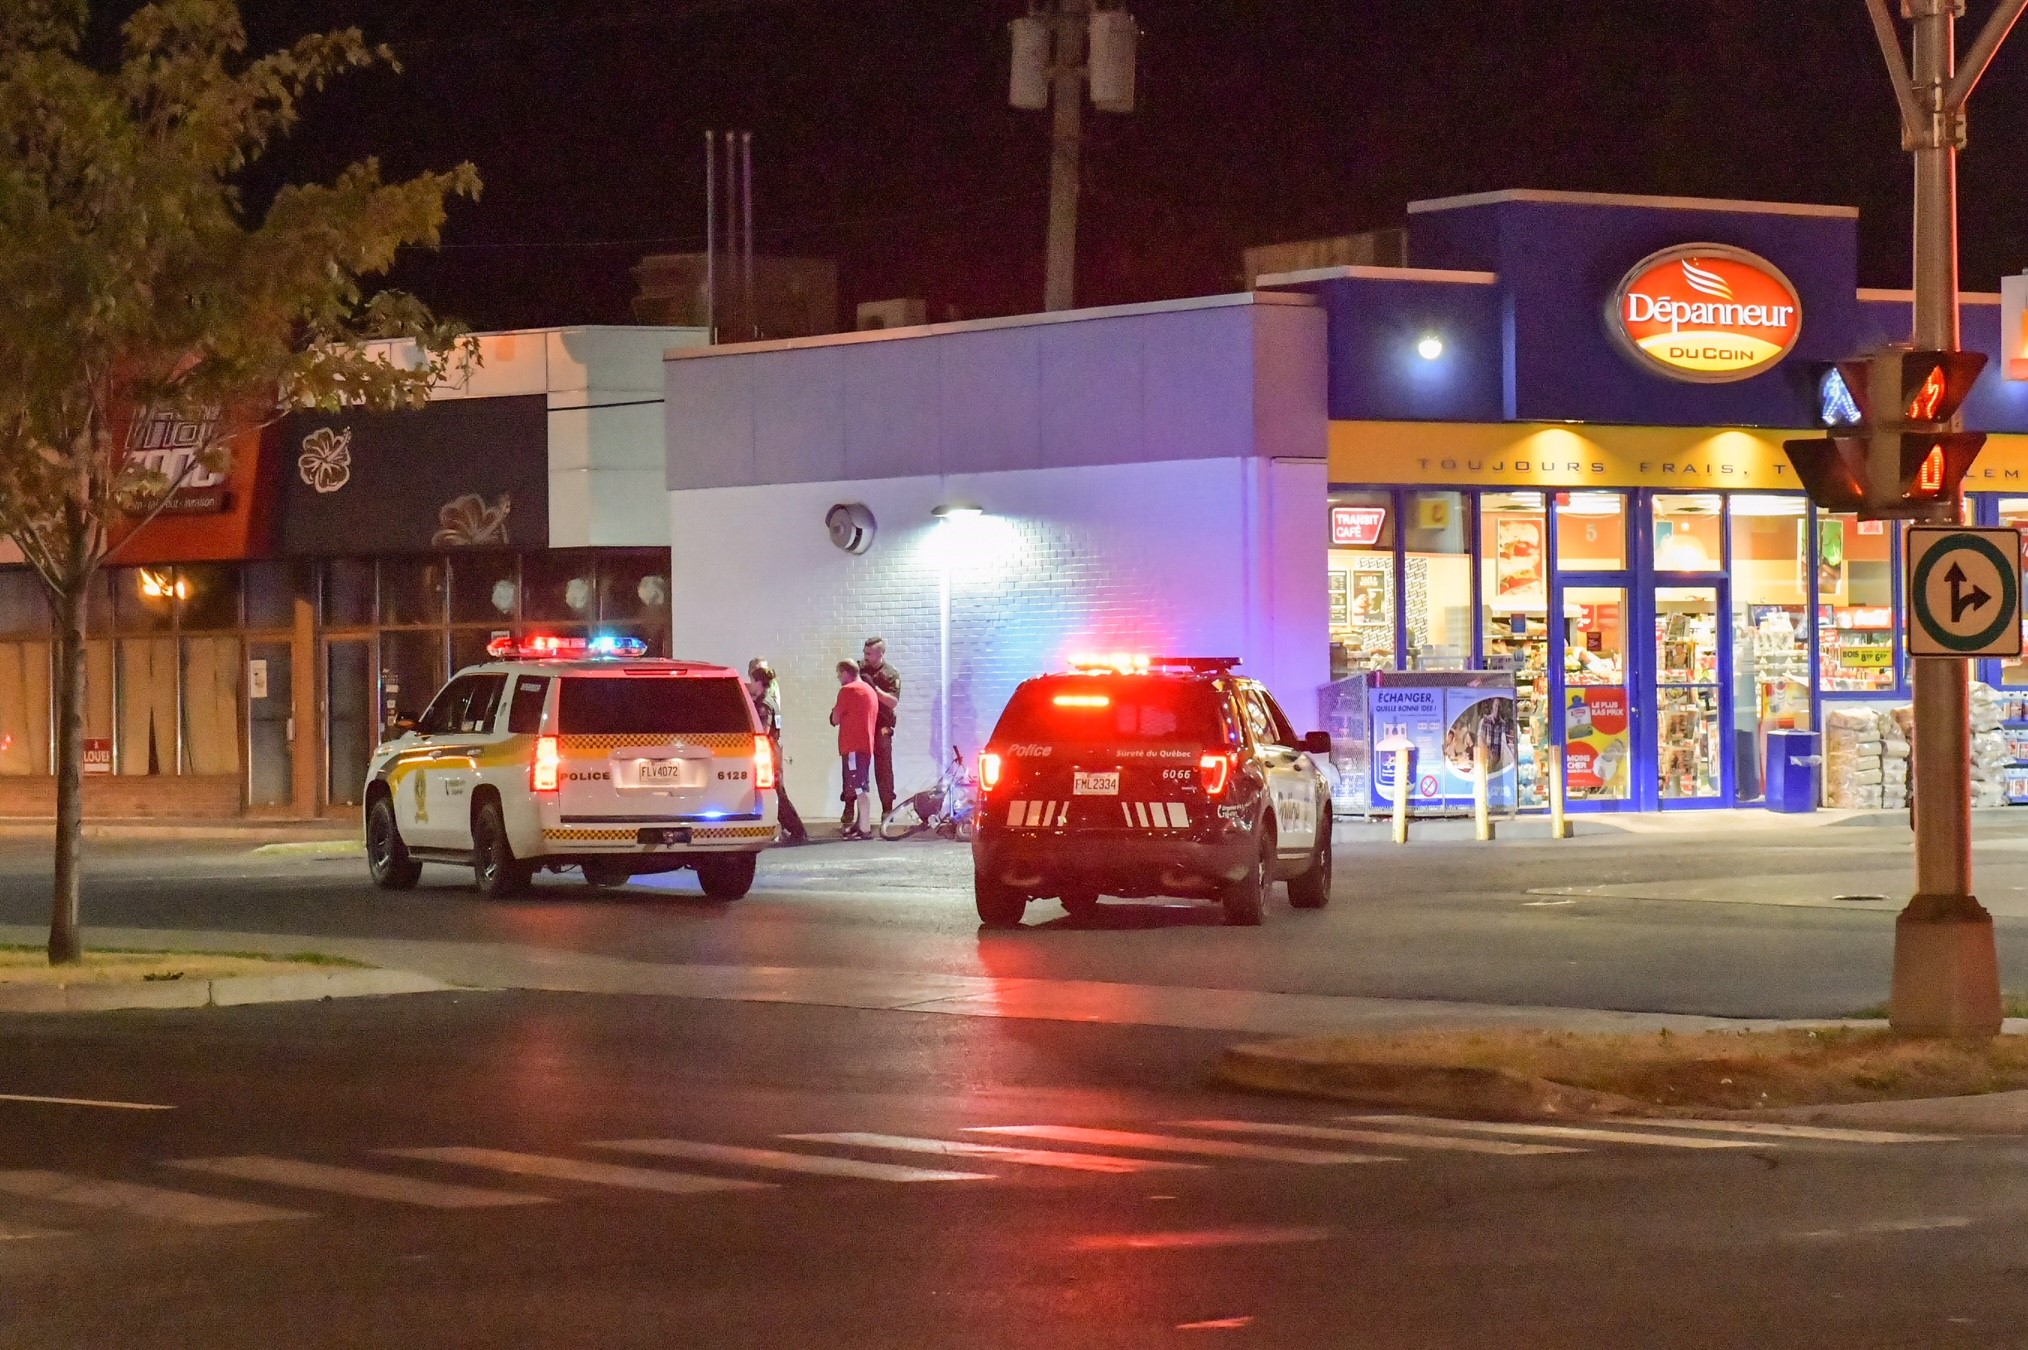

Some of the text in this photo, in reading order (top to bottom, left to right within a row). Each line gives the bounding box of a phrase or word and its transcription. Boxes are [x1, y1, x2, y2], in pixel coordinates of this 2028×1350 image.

[1627, 293, 1793, 334] Dépanneur
[1416, 458, 1605, 473] TOUJOURS
[1639, 462, 1750, 478] FRAIS,
[1336, 524, 1362, 538] CAFÉ
[1007, 743, 1053, 758] Police
[1146, 749, 1158, 758] du
[1159, 749, 1192, 759] Québec
[559, 771, 611, 781] POLICE
[641, 766, 679, 777] FLV4072
[717, 771, 748, 781] 6128
[1162, 769, 1191, 780] 6066
[1075, 778, 1117, 790] FML2334
